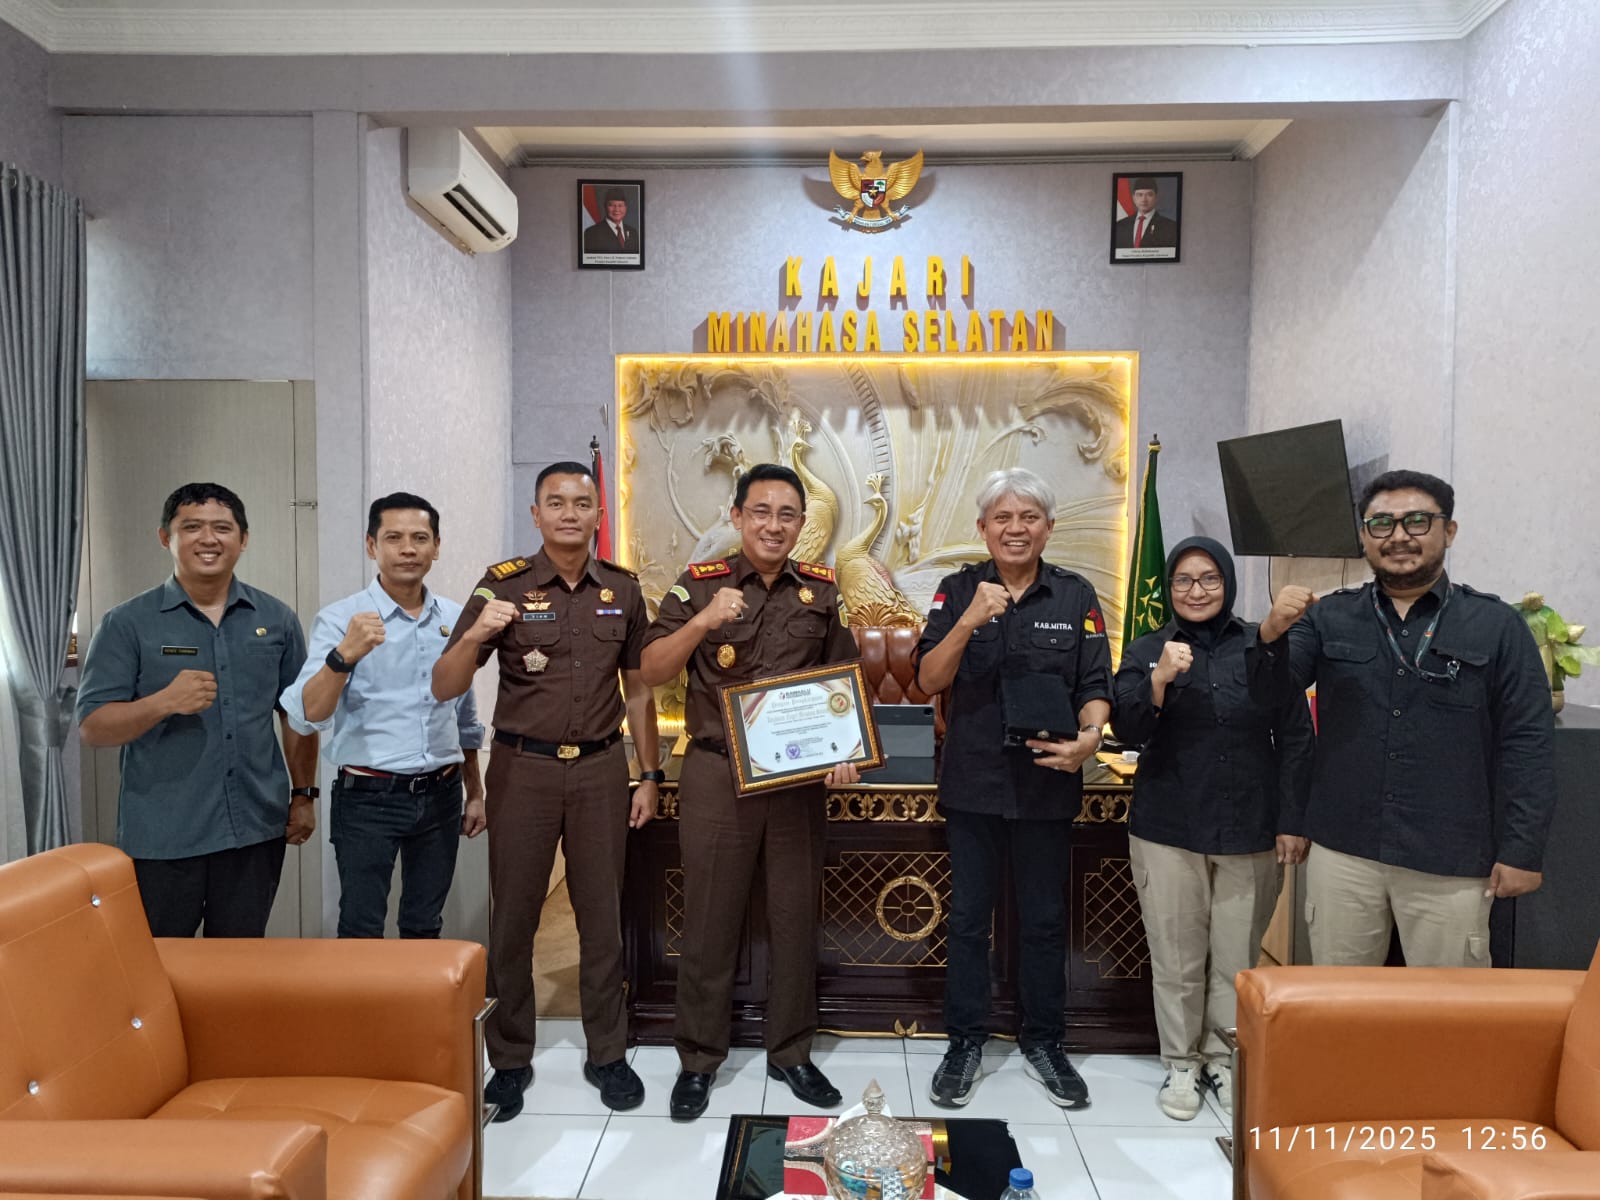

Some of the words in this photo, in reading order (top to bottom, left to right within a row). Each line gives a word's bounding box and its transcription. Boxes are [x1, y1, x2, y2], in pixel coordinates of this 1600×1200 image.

[786, 255, 970, 297] KAJARI
[707, 310, 881, 352] MINAHASA
[903, 309, 1053, 352] SELATAN
[1034, 621, 1073, 631] KAB.MITRA
